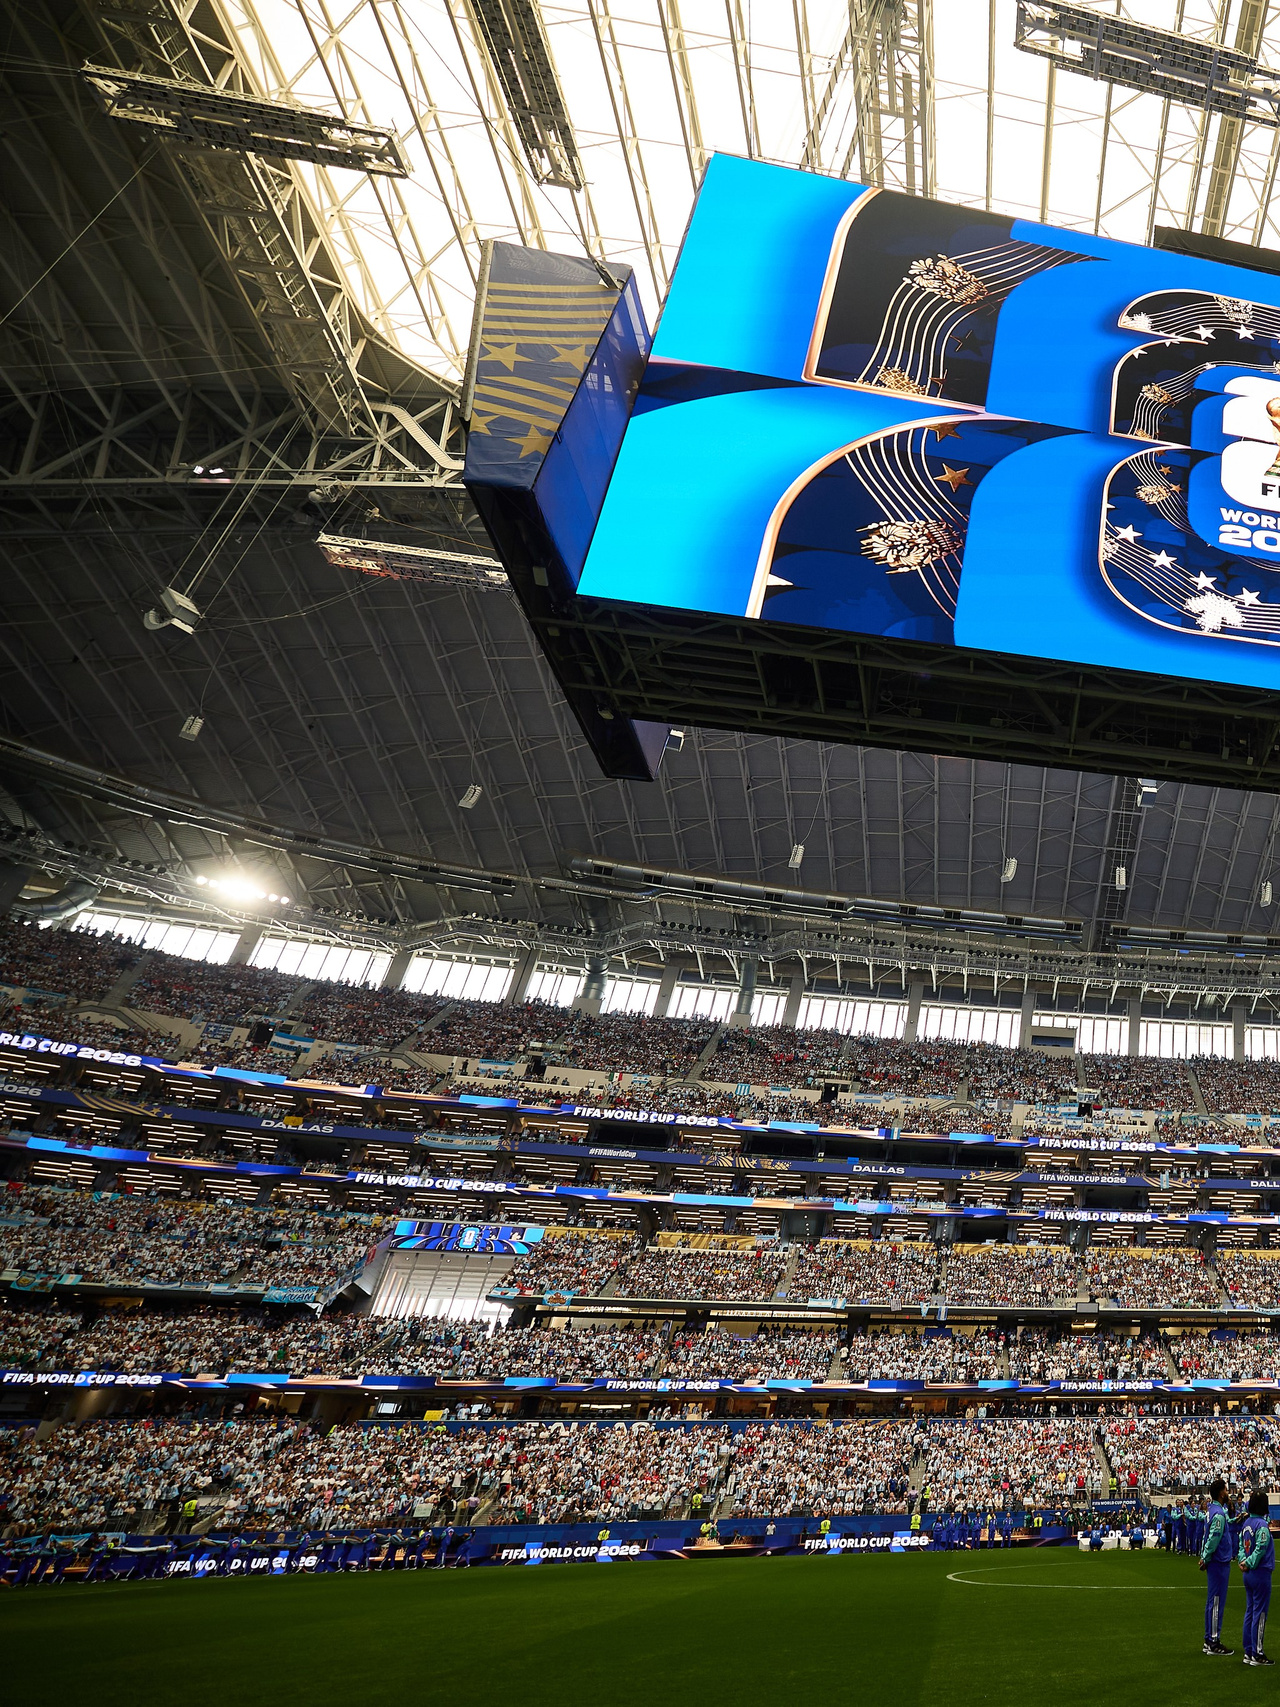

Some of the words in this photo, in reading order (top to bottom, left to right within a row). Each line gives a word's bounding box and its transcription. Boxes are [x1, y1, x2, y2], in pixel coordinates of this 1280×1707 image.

[38, 1040, 77, 1055] CUP
[76, 1047, 142, 1067] 2026
[573, 1106, 601, 1118] FIFA
[602, 1109, 648, 1122] WORLD
[650, 1113, 675, 1123] CUP
[675, 1114, 719, 1127] 2026
[260, 1119, 334, 1134] DALLAS
[1039, 1138, 1060, 1148] FIFA
[1062, 1139, 1098, 1150] WORLD
[1099, 1140, 1120, 1150] CUP
[1121, 1141, 1156, 1152] 2026
[589, 1148, 637, 1158] #FIFAWorldCup
[853, 1165, 905, 1175] DALLAS
[355, 1173, 384, 1185] FIFA
[387, 1175, 434, 1188] WORLD
[435, 1179, 462, 1190] CUP
[461, 1180, 507, 1193] 2026
[1039, 1174, 1057, 1182] FIFA
[1057, 1175, 1083, 1183] WORLD
[1044, 1211, 1065, 1221] FIFA
[1067, 1212, 1099, 1222] WORLD
[1101, 1213, 1119, 1222] CUP
[1119, 1213, 1152, 1223] 2026
[3, 1373, 34, 1384] FIFA
[36, 1373, 86, 1385] WORLD
[87, 1374, 116, 1384] CUP
[115, 1375, 163, 1385] 2026
[605, 1380, 627, 1391] FIFA
[627, 1380, 665, 1391] WORLD
[665, 1380, 685, 1391] CUP
[685, 1381, 720, 1390] 2026
[1060, 1381, 1078, 1391] FIFA
[1078, 1381, 1108, 1391] WORLD
[1108, 1381, 1125, 1390] CUP
[1125, 1381, 1153, 1390] 2026
[804, 1539, 828, 1550] FIFA
[829, 1538, 868, 1549] WORLD
[869, 1537, 891, 1547] CUP
[890, 1536, 929, 1546] 2026
[501, 1549, 528, 1560] FIFA
[529, 1547, 572, 1560] WORLD
[572, 1546, 598, 1558] CUP
[599, 1545, 640, 1556] 2026
